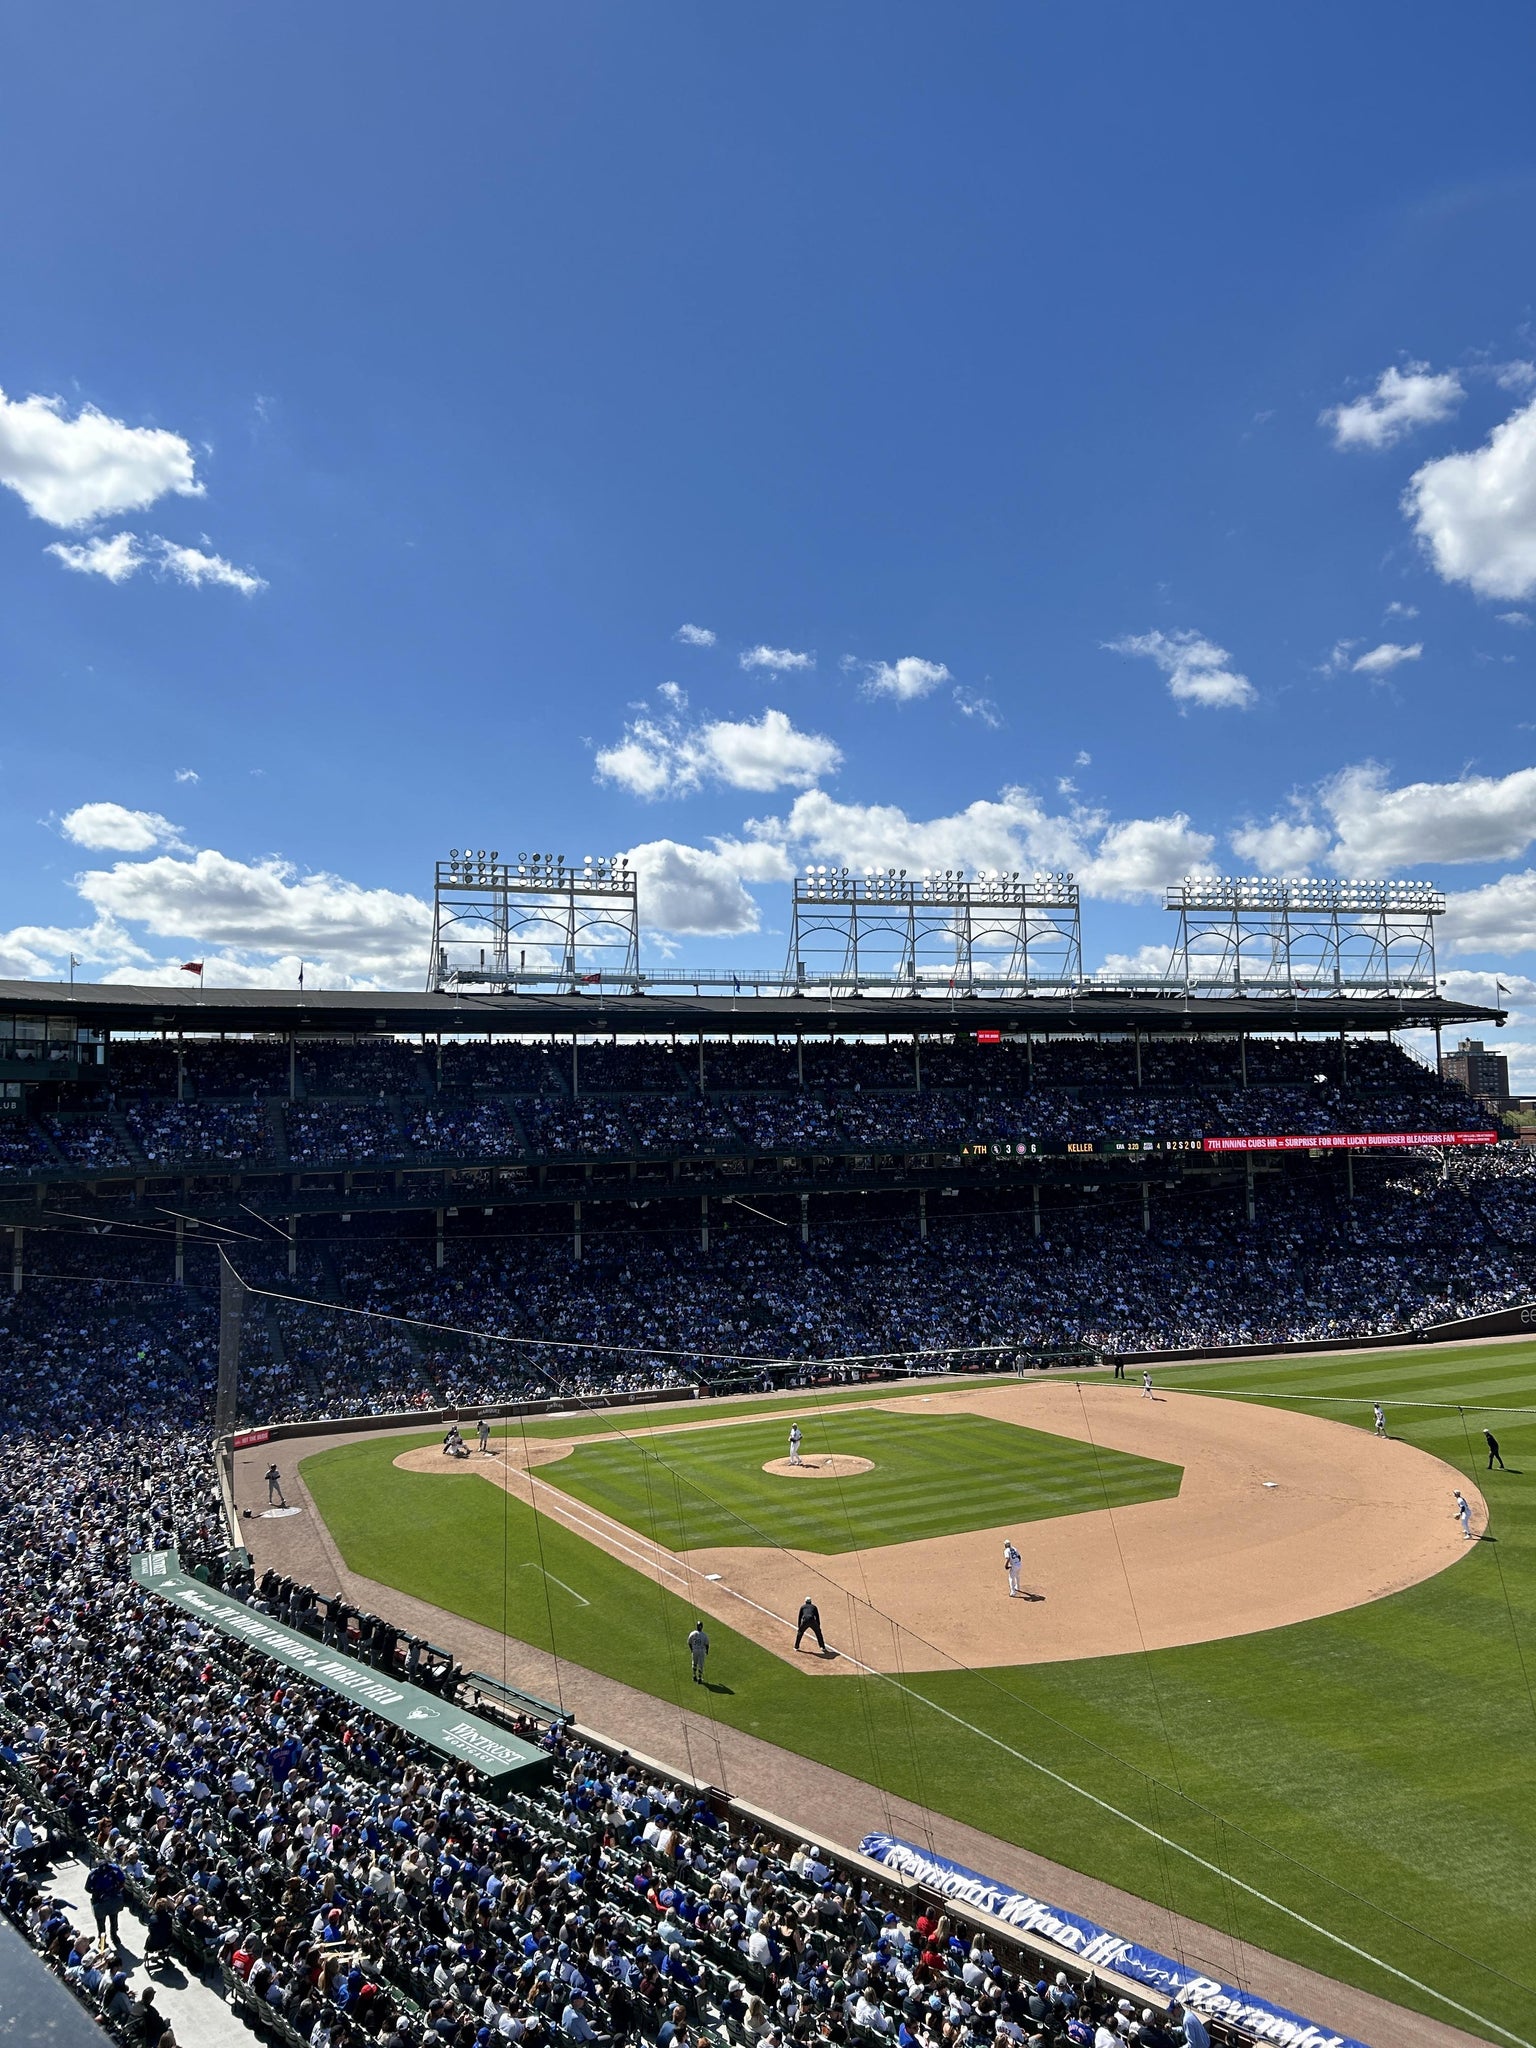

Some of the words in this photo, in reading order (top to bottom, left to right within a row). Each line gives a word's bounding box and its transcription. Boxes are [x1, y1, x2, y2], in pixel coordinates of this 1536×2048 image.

[973, 1145, 987, 1154] 7TH
[1005, 1144, 1011, 1153] 3
[1031, 1143, 1036, 1153] 6
[1067, 1143, 1093, 1153] KELLER
[1208, 1140, 1221, 1149] 7TH
[1222, 1140, 1246, 1148] INNING
[1248, 1139, 1266, 1148] CUBS
[1267, 1138, 1277, 1147] HR
[1285, 1138, 1317, 1147] SURPRISE
[1319, 1138, 1332, 1146] FOR
[1333, 1137, 1346, 1145] ONE
[1347, 1136, 1367, 1145] LUCKY
[1368, 1135, 1405, 1145] BUDWEISER
[1407, 1135, 1442, 1144] BLEACHERS
[1443, 1134, 1455, 1143] FAN
[262, 1630, 319, 1660] CONFINES
[316, 1661, 374, 1689] WRIGLEY
[363, 1682, 405, 1705] FIELD
[442, 1735, 495, 1763] MORTGAGE
[449, 1722, 527, 1763] WINTRUST
